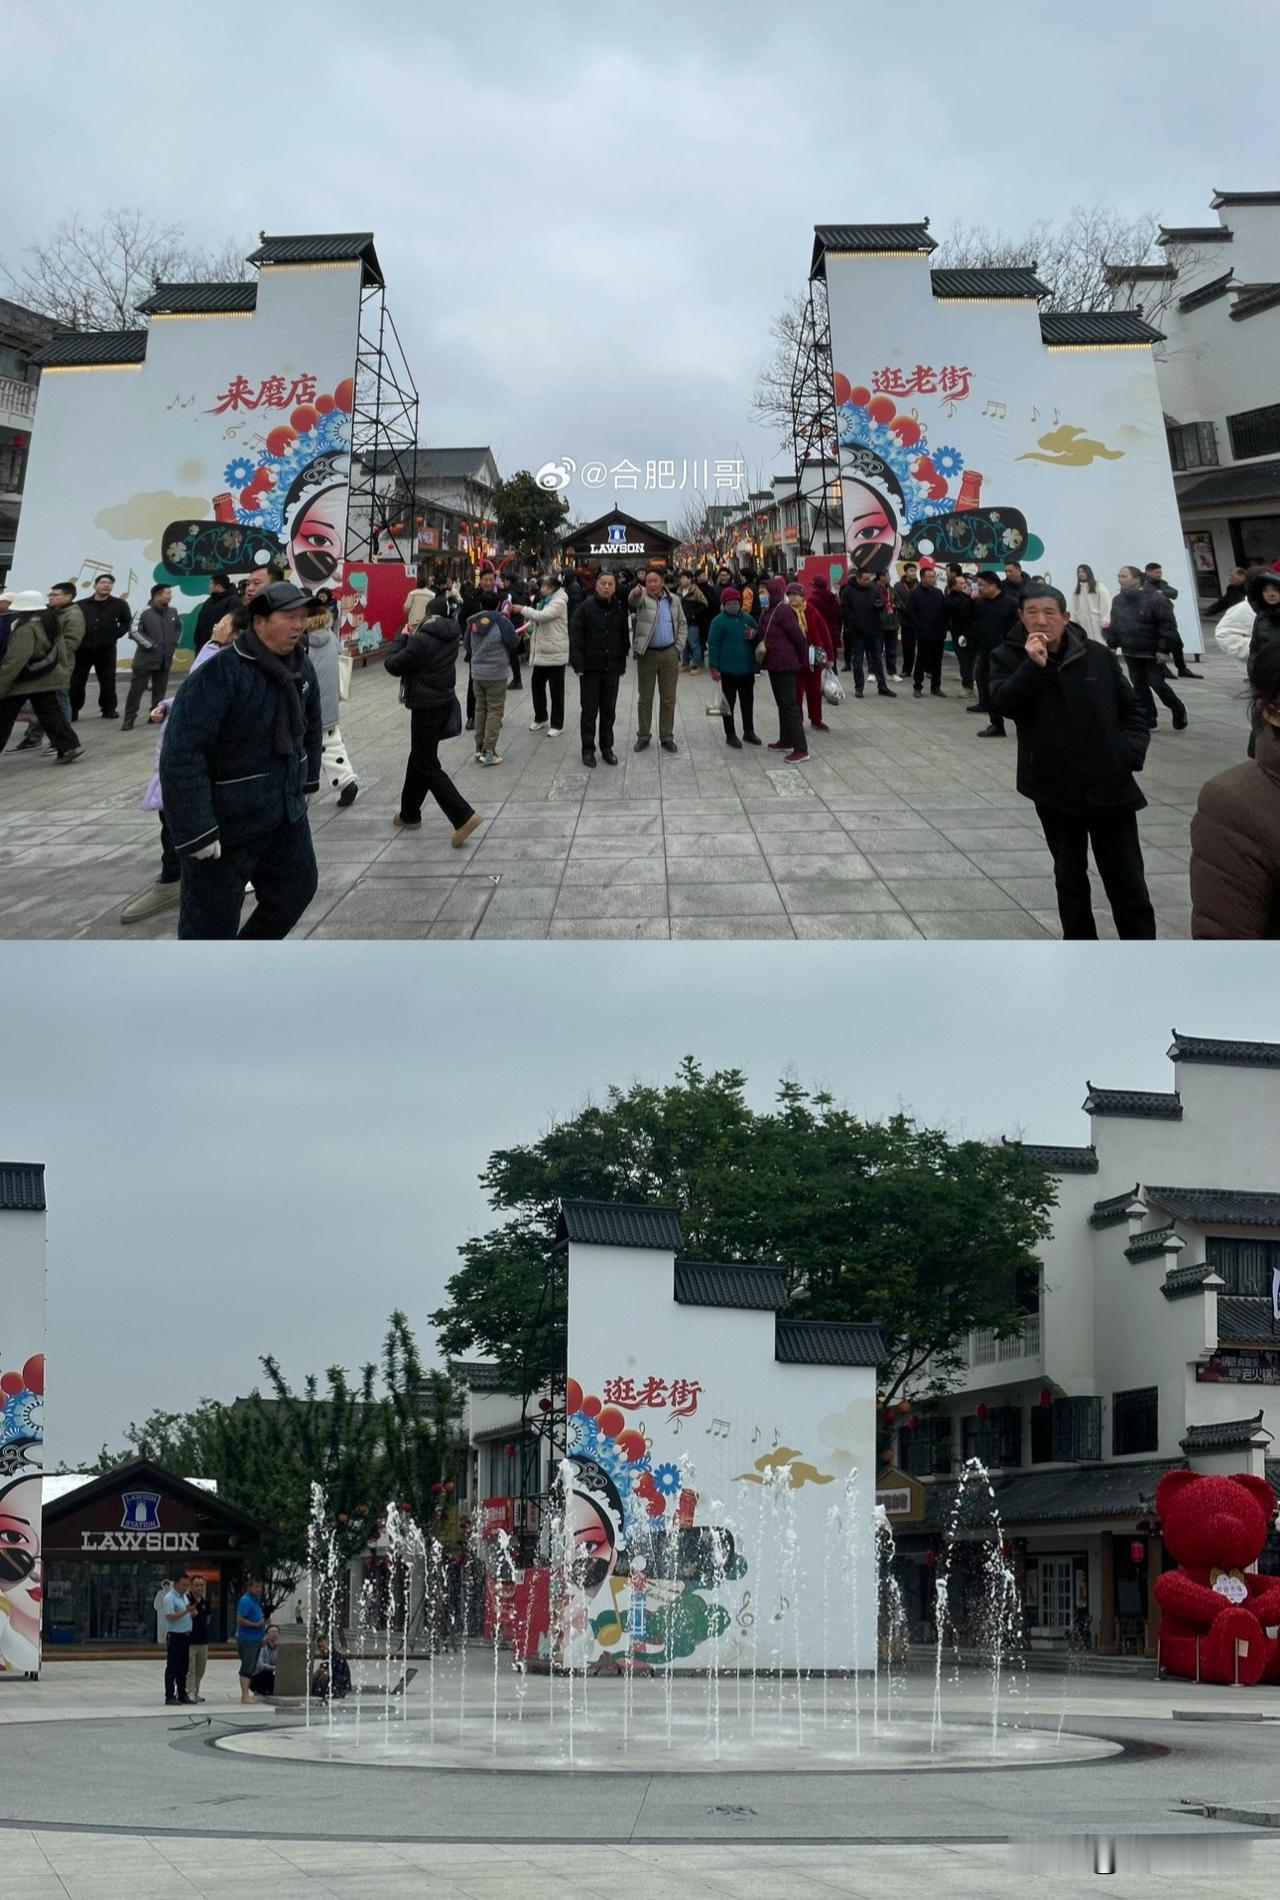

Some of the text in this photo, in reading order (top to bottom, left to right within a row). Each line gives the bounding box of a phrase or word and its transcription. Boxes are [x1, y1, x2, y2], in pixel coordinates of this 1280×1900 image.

[203, 373, 317, 414] 来磨店
[872, 364, 972, 407] 逛老街
[590, 543, 645, 554] LAWSON
[604, 1376, 702, 1423] 逛老街
[125, 1519, 156, 1529] STATION
[81, 1531, 200, 1551] LAWSON
